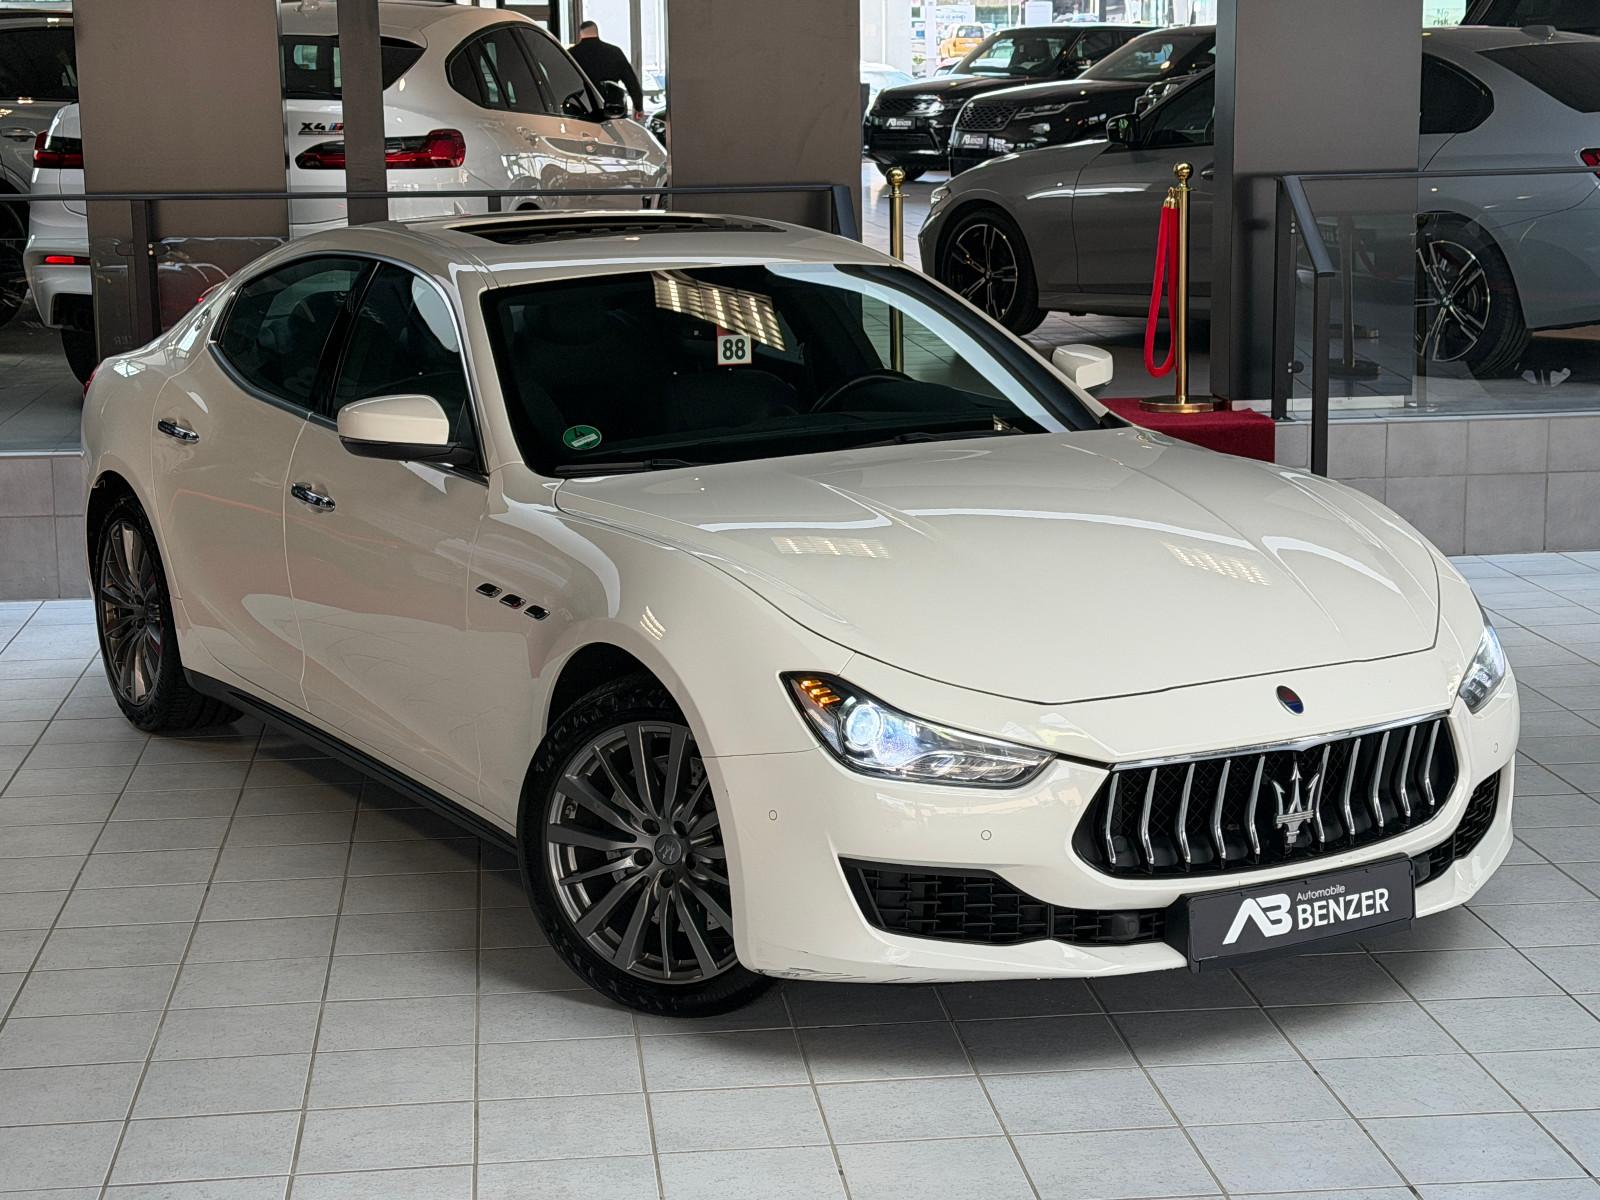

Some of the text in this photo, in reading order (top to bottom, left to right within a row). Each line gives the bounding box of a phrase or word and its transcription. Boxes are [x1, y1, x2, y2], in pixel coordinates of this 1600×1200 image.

[301, 122, 325, 131] X4
[723, 338, 745, 360] 88
[1296, 884, 1346, 902] Automobile
[1296, 888, 1390, 930] BENZER
